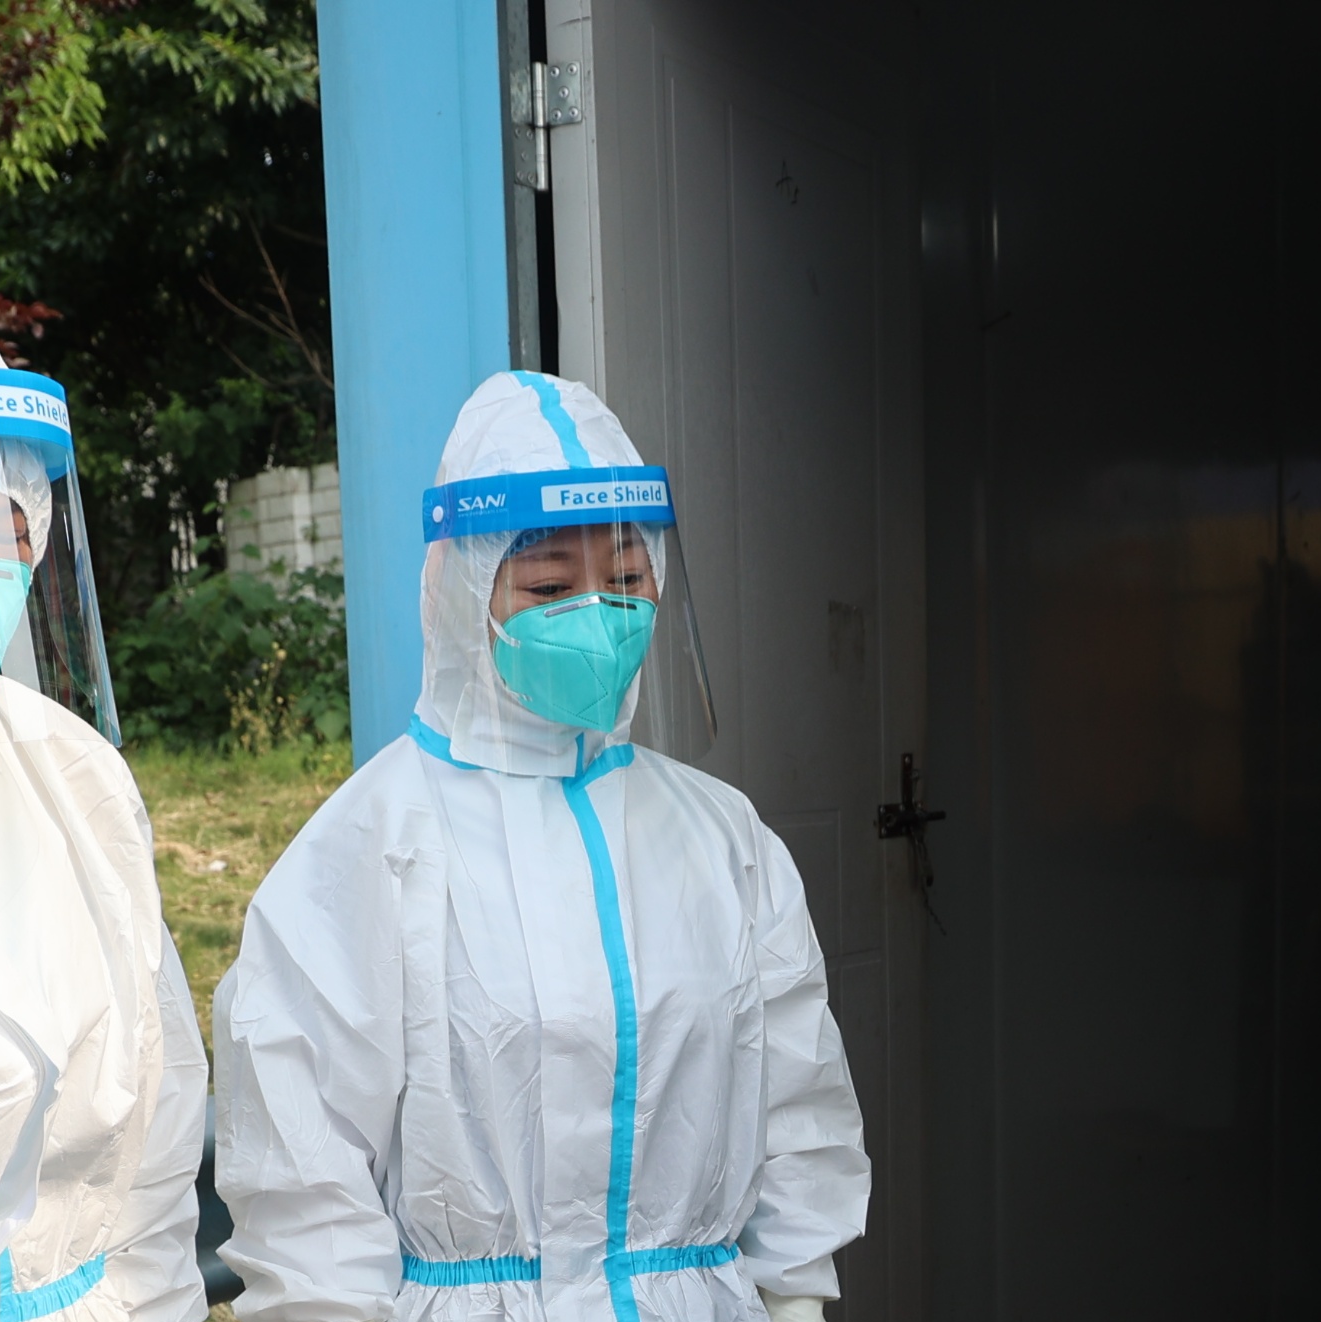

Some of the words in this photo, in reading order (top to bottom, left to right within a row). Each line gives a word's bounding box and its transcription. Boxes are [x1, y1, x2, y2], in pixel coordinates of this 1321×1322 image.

[24, 395, 69, 427] Shield
[457, 493, 506, 513] SANI
[560, 489, 608, 506] Face
[614, 485, 662, 504] Shield
